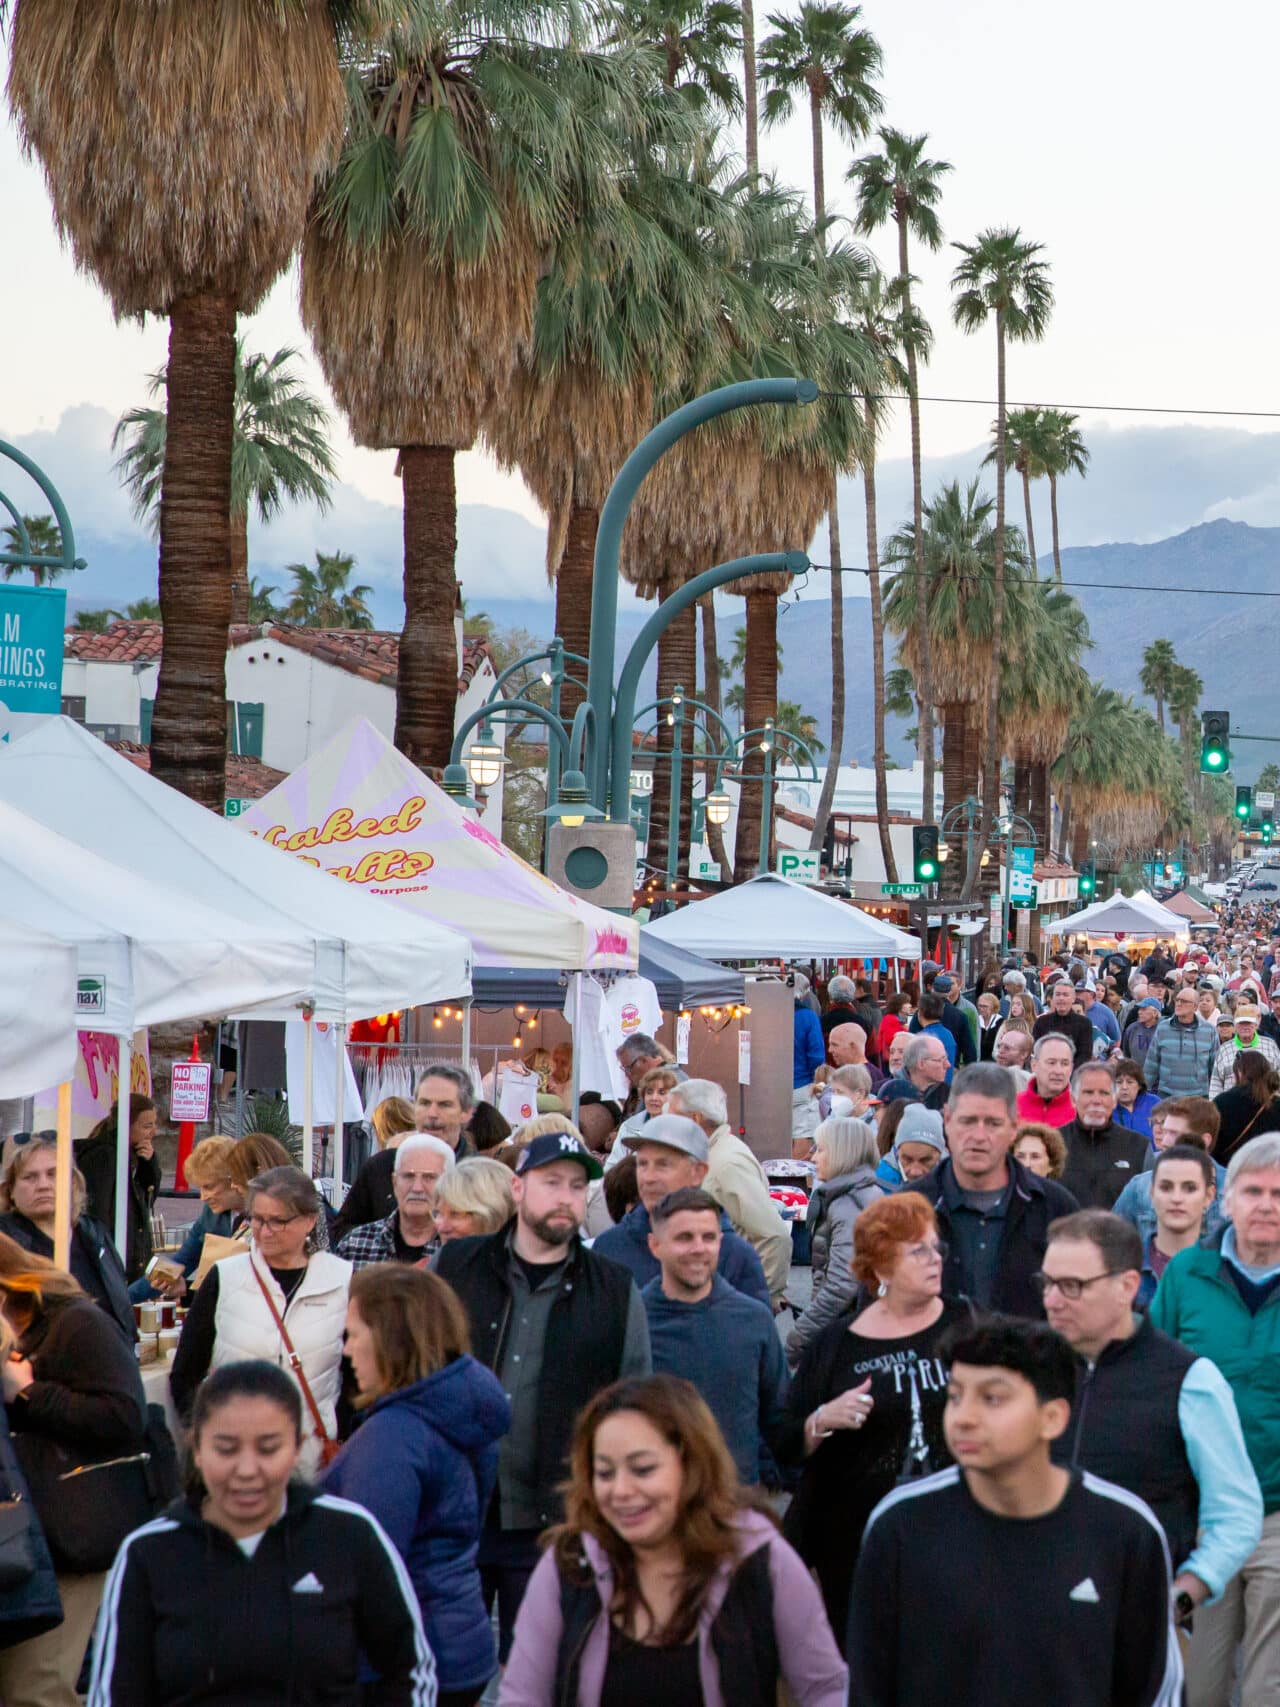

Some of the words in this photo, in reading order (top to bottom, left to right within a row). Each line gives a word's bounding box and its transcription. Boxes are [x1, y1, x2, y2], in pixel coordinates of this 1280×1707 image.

[0, 646, 46, 678] INGS
[230, 801, 238, 814] 3
[174, 1067, 190, 1078] NO
[174, 1083, 206, 1091] PARKING
[559, 1134, 579, 1152] NY
[854, 1350, 917, 1373] COCKTAILS
